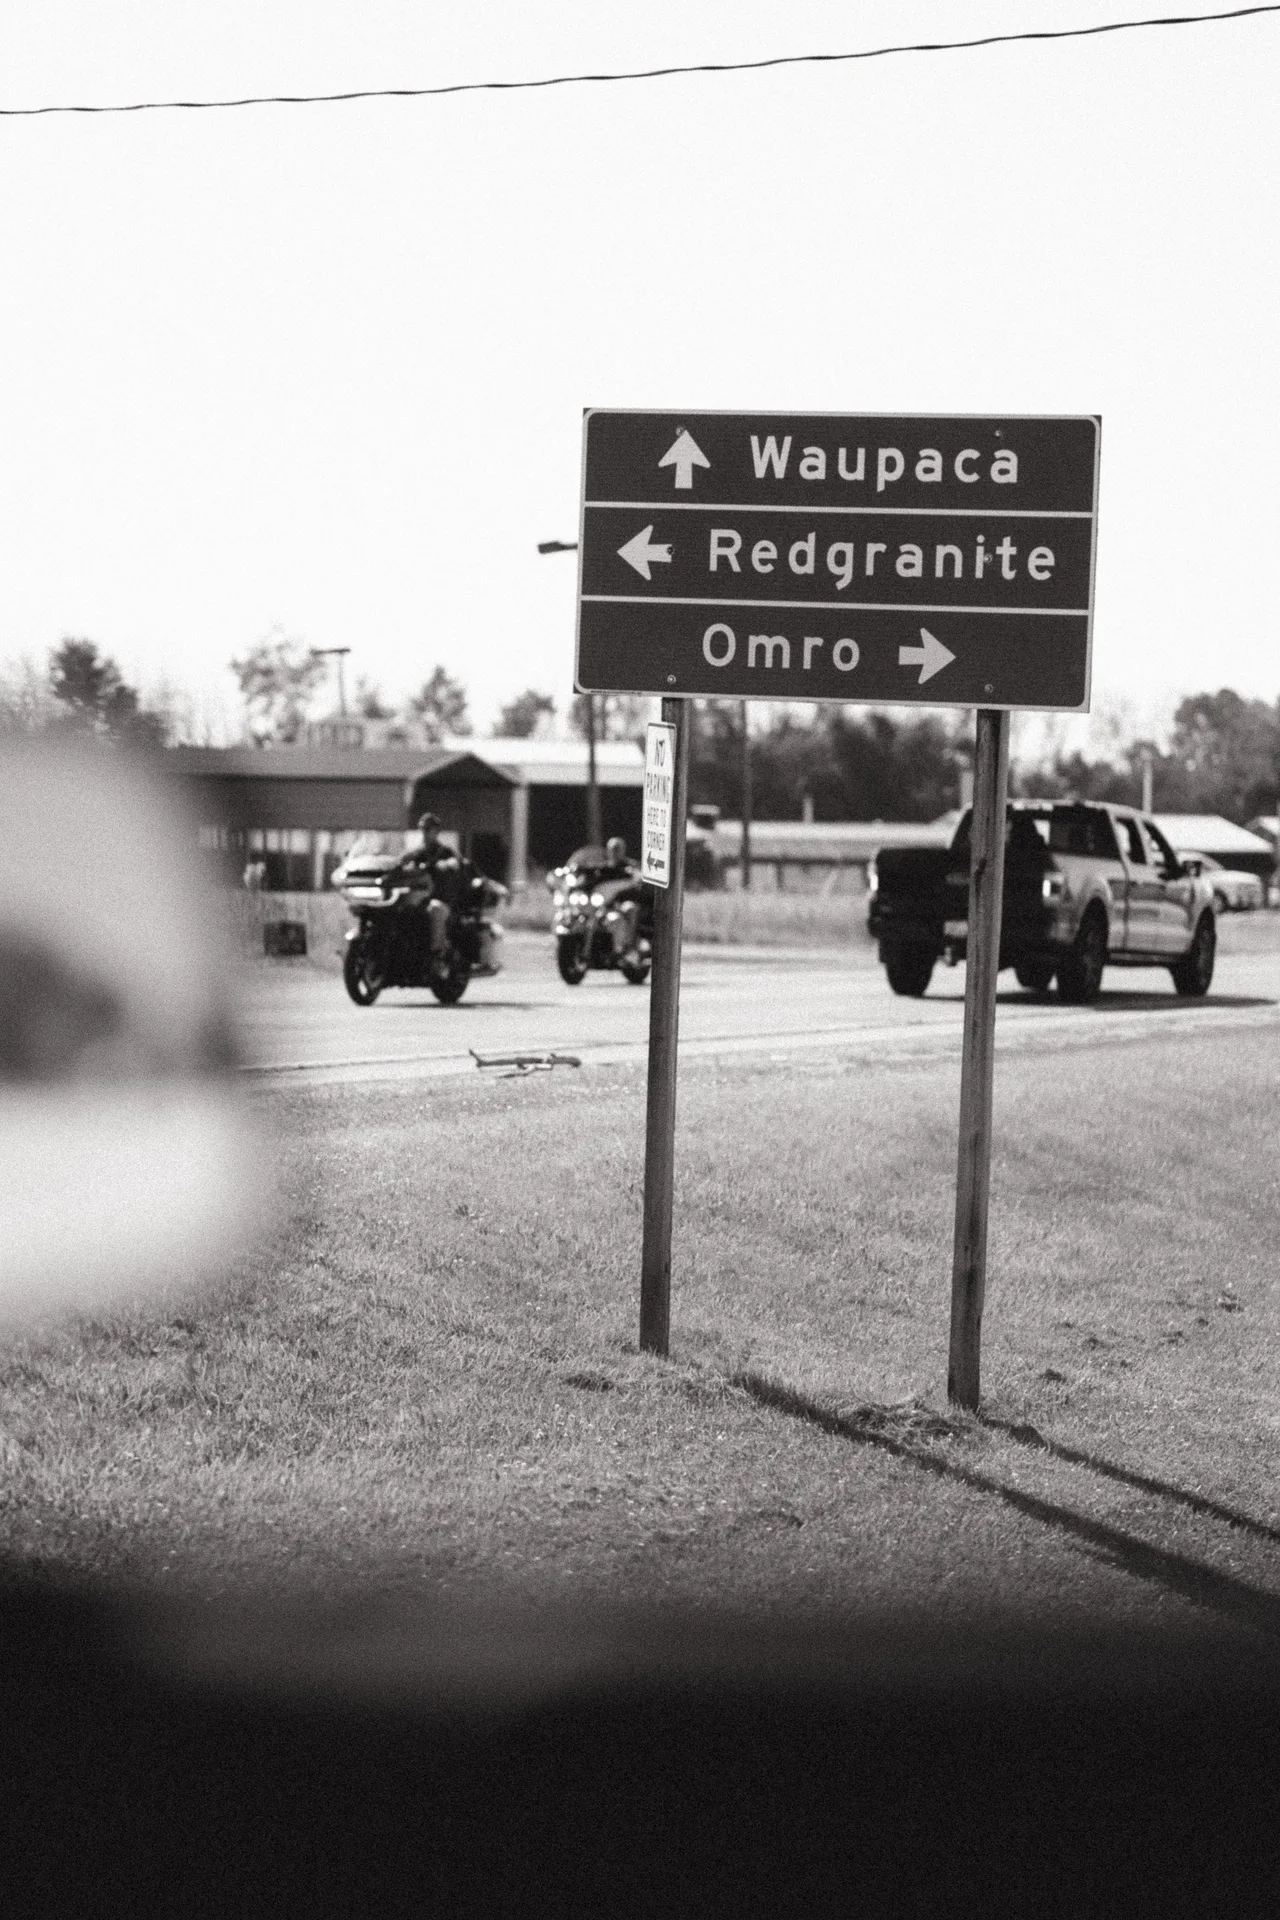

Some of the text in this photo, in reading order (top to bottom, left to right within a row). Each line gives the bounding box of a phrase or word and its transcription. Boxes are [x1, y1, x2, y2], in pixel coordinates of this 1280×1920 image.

[750, 434, 1018, 492] Waupaca
[709, 528, 1056, 590] Redgranite
[702, 622, 860, 671] Omro
[654, 738, 666, 767] NO
[646, 772, 670, 804] PARKING
[647, 807, 667, 828] HERE TO
[647, 830, 665, 851] CORNER
